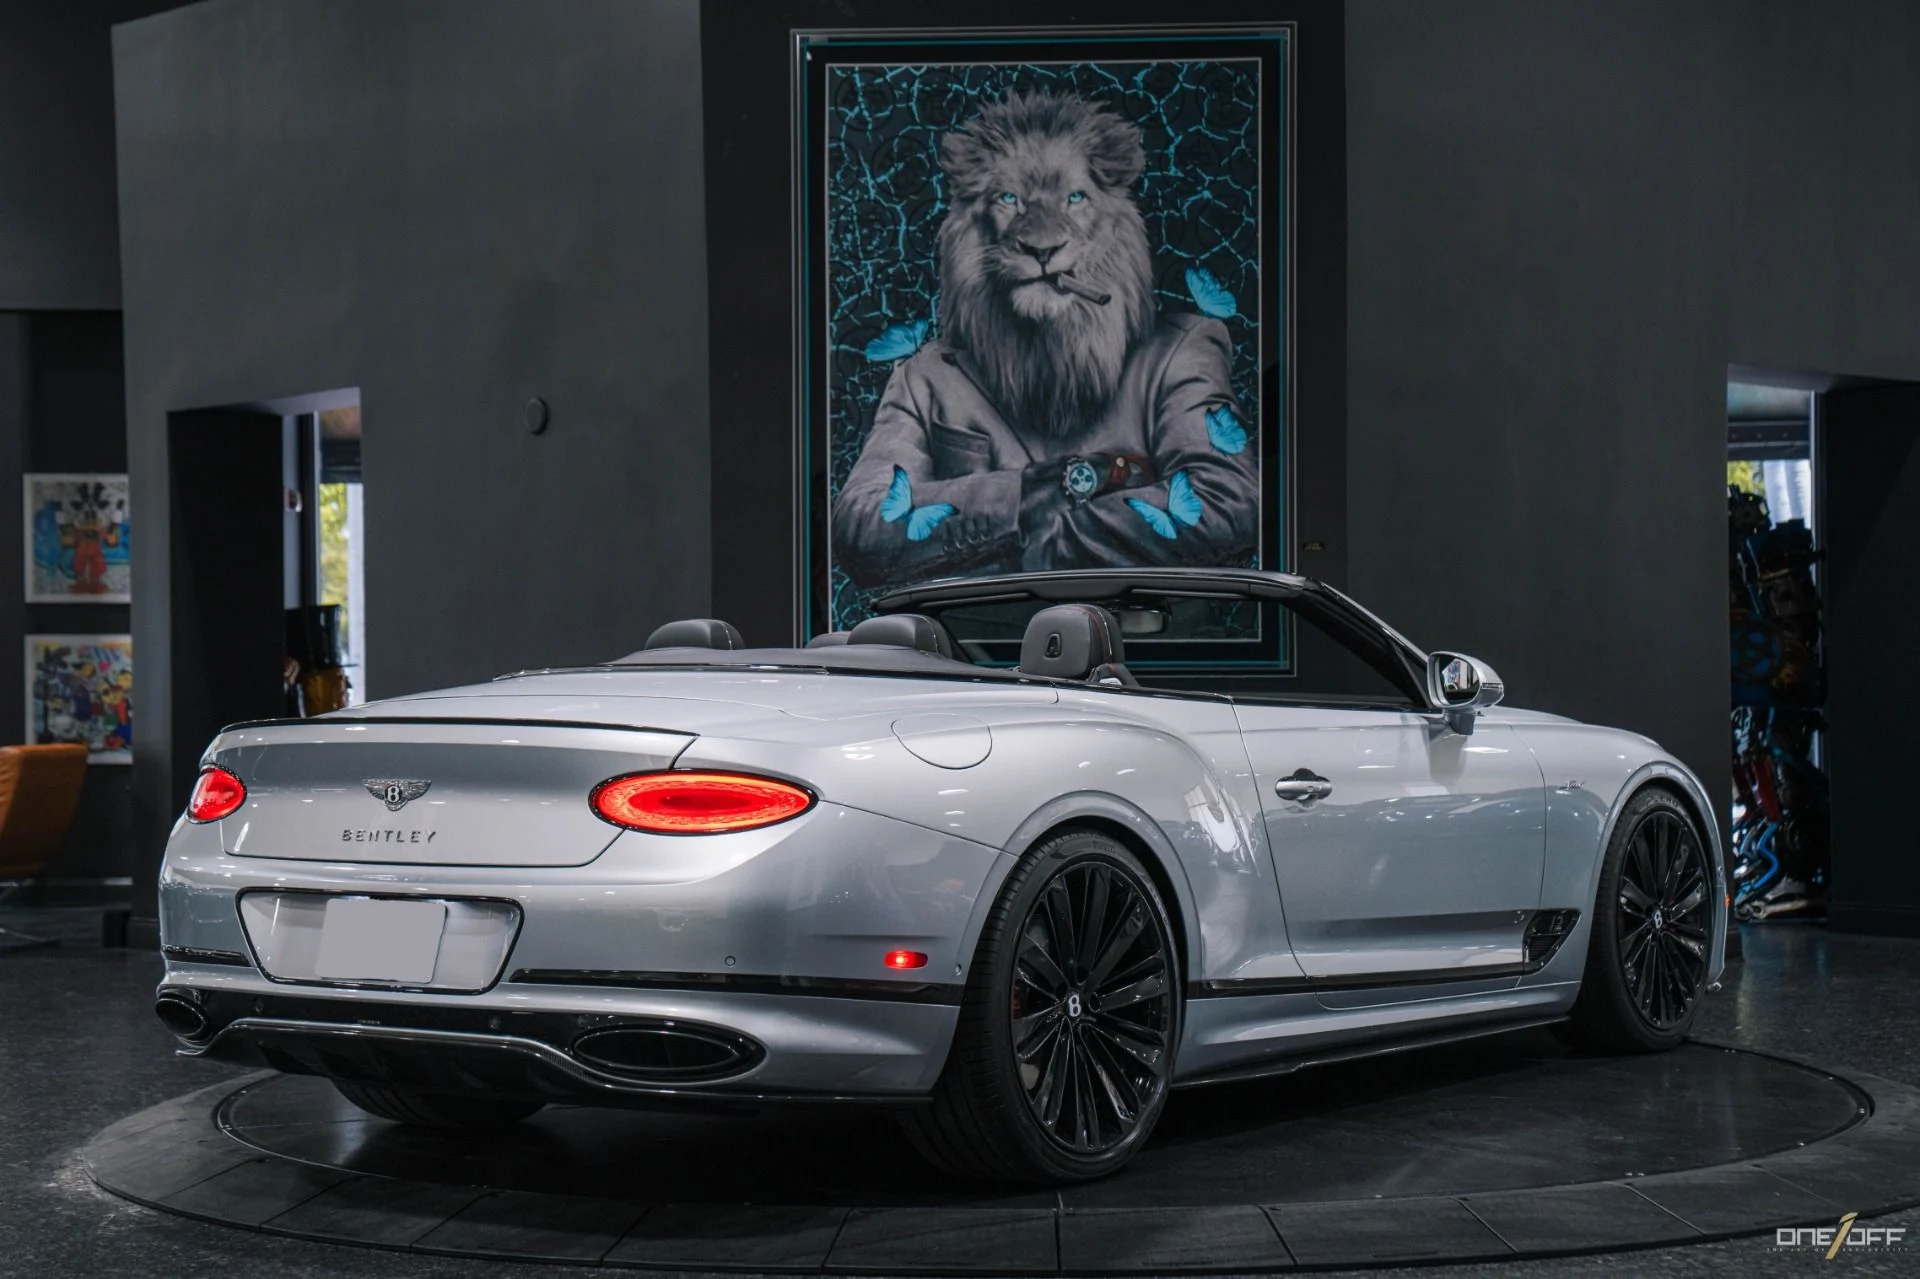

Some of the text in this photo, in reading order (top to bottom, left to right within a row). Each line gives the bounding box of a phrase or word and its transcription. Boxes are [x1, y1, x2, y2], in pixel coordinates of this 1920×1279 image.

[387, 785, 400, 803] B
[342, 829, 436, 843] BENTLEY
[1068, 994, 1081, 1017] B
